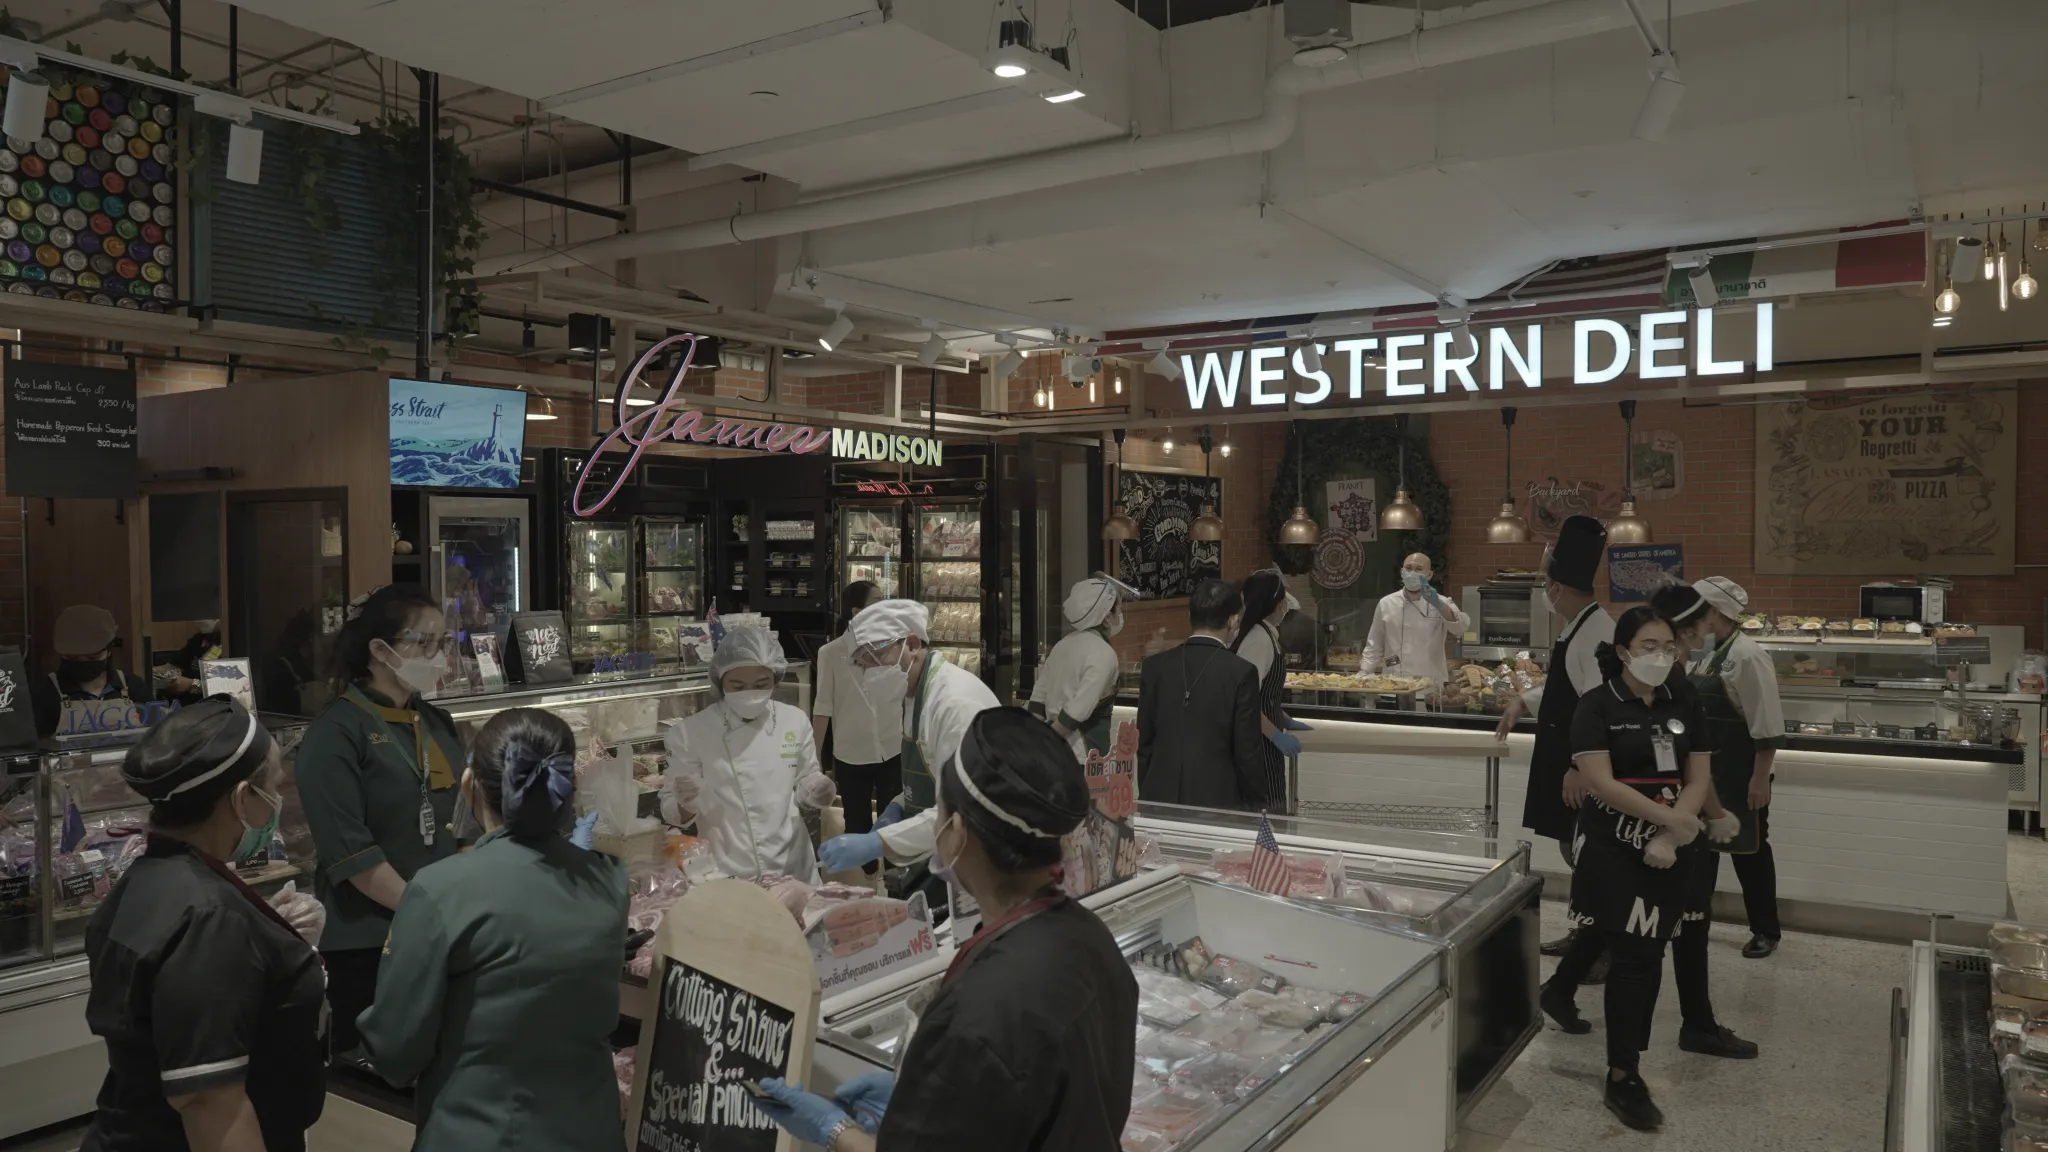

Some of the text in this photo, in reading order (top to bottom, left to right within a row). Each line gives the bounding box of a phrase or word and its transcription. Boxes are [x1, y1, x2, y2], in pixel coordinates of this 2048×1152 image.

[1181, 302, 1773, 410] WESTERN DELI
[33, 380, 52, 390] Lamb
[389, 396, 447, 418] ss Strait
[17, 419, 53, 430] Homemade
[573, 333, 831, 516] James
[1859, 416, 1948, 437] YOUR
[832, 428, 943, 467] MADISON
[1860, 439, 1917, 460] Regretti
[1527, 480, 1581, 499] Backyard
[1905, 480, 1948, 499] PIZZA
[592, 651, 657, 673] JAGOA
[1616, 813, 1657, 849] Life
[665, 964, 727, 1046] Cutting
[649, 1069, 708, 1124] Special
